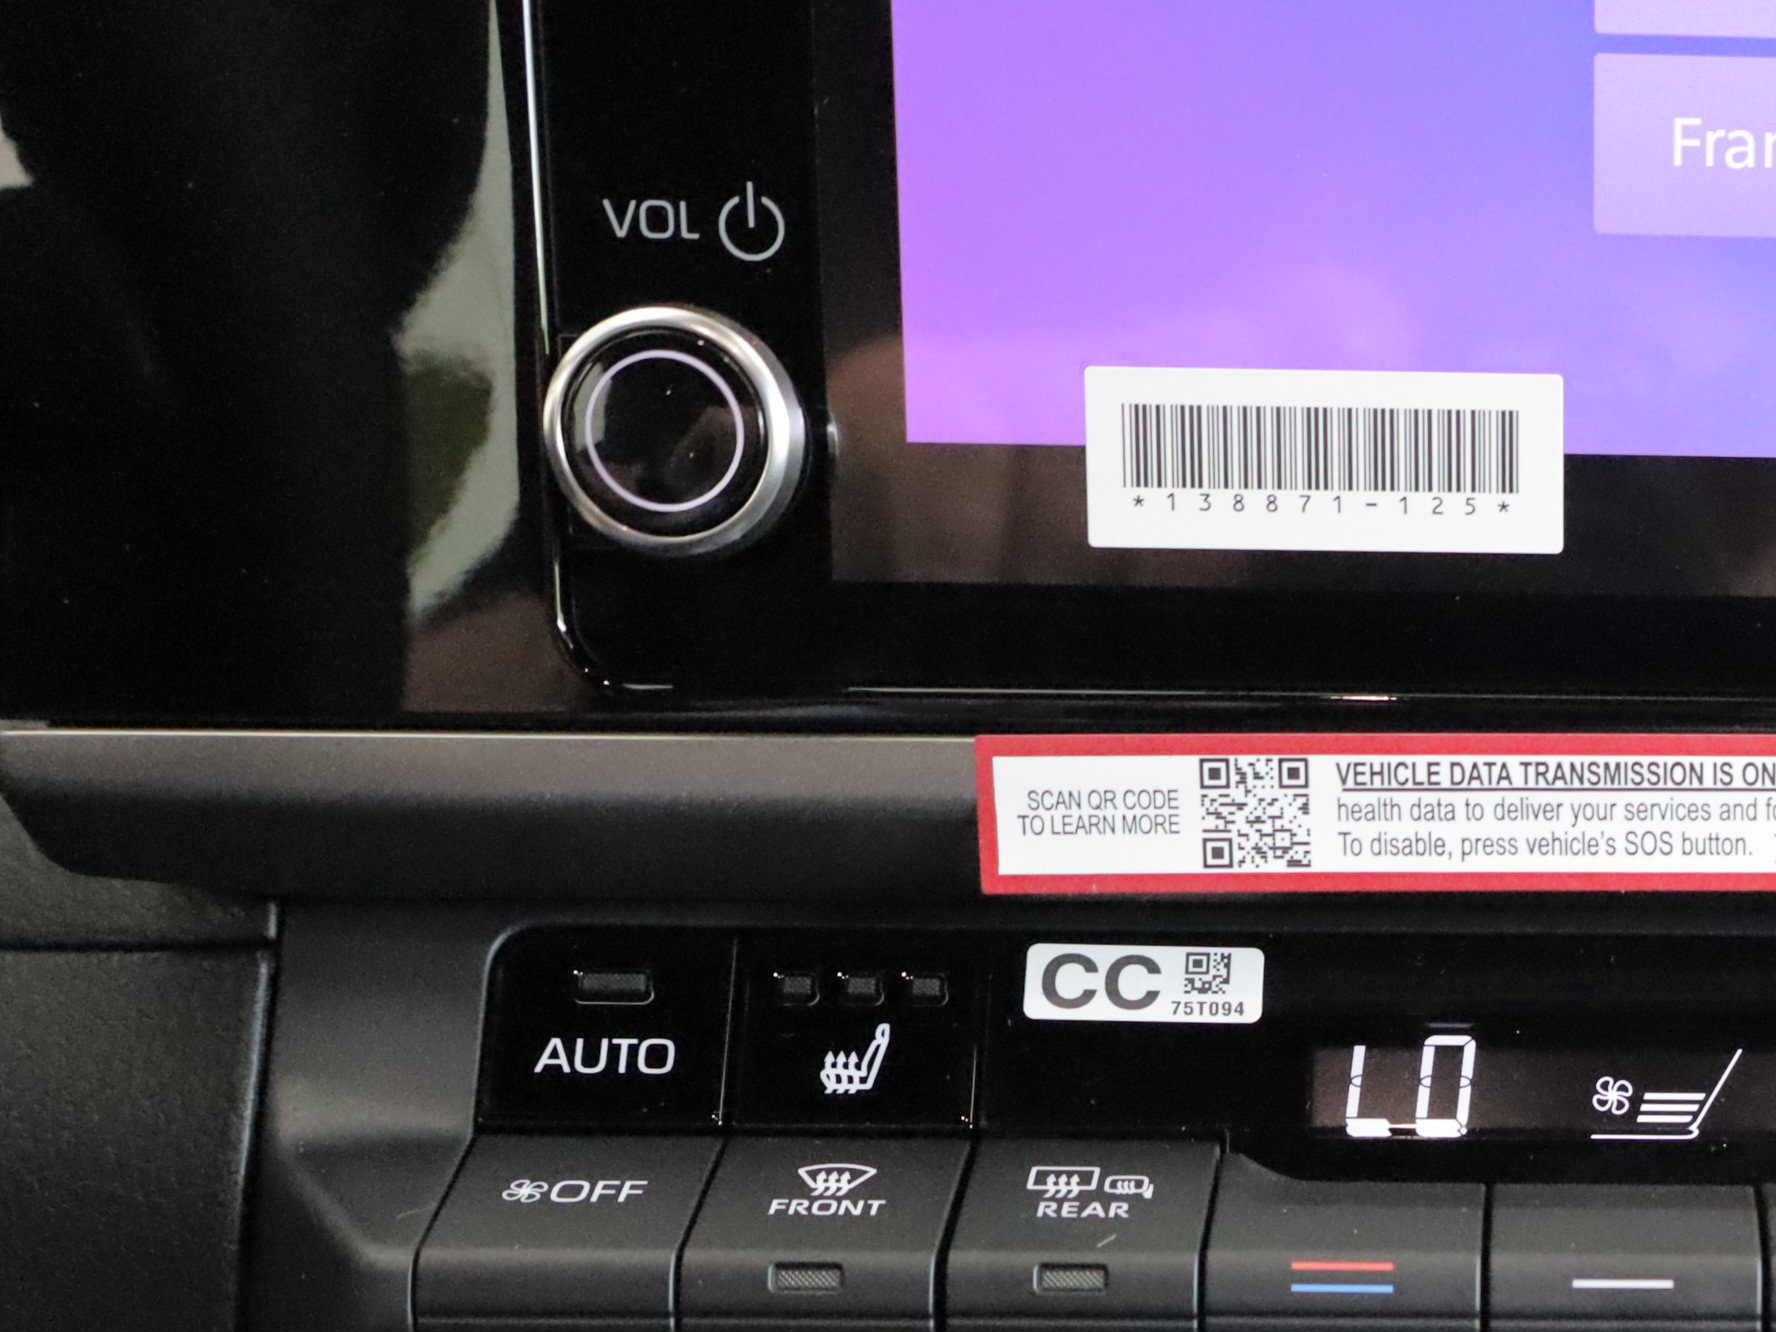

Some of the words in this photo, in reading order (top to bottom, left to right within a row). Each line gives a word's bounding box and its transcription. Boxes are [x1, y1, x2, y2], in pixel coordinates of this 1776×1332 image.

[602, 198, 700, 240] VOL
[1336, 761, 1441, 787] VEHICLE
[1450, 761, 1512, 786] DATA
[1519, 761, 1704, 786] TRANSMISSION
[1713, 761, 1734, 786] IS
[1027, 789, 1082, 811] SCAN
[1087, 789, 1118, 811] QR
[1123, 789, 1180, 810] CODE
[1337, 797, 1402, 822] health
[1409, 797, 1456, 822] data
[1465, 798, 1484, 822] to
[1494, 797, 1564, 821] deliver
[1571, 802, 1617, 828] your
[1624, 797, 1711, 822] services
[1719, 797, 1757, 822] and
[1017, 814, 1045, 836] TO
[1050, 814, 1116, 835] LEARN
[1122, 814, 1181, 834] MORE
[1337, 832, 1362, 857] To
[1370, 832, 1452, 860] disable,
[1461, 837, 1518, 862] press
[1624, 831, 1674, 856] SOS
[1682, 832, 1752, 856] button.
[1041, 952, 1162, 1011] CC
[1171, 1001, 1245, 1017] 75T094
[533, 1037, 676, 1075] AUTO
[550, 1179, 648, 1205] OFF
[768, 1198, 886, 1217] FRONT
[1036, 1201, 1130, 1219] REAR
